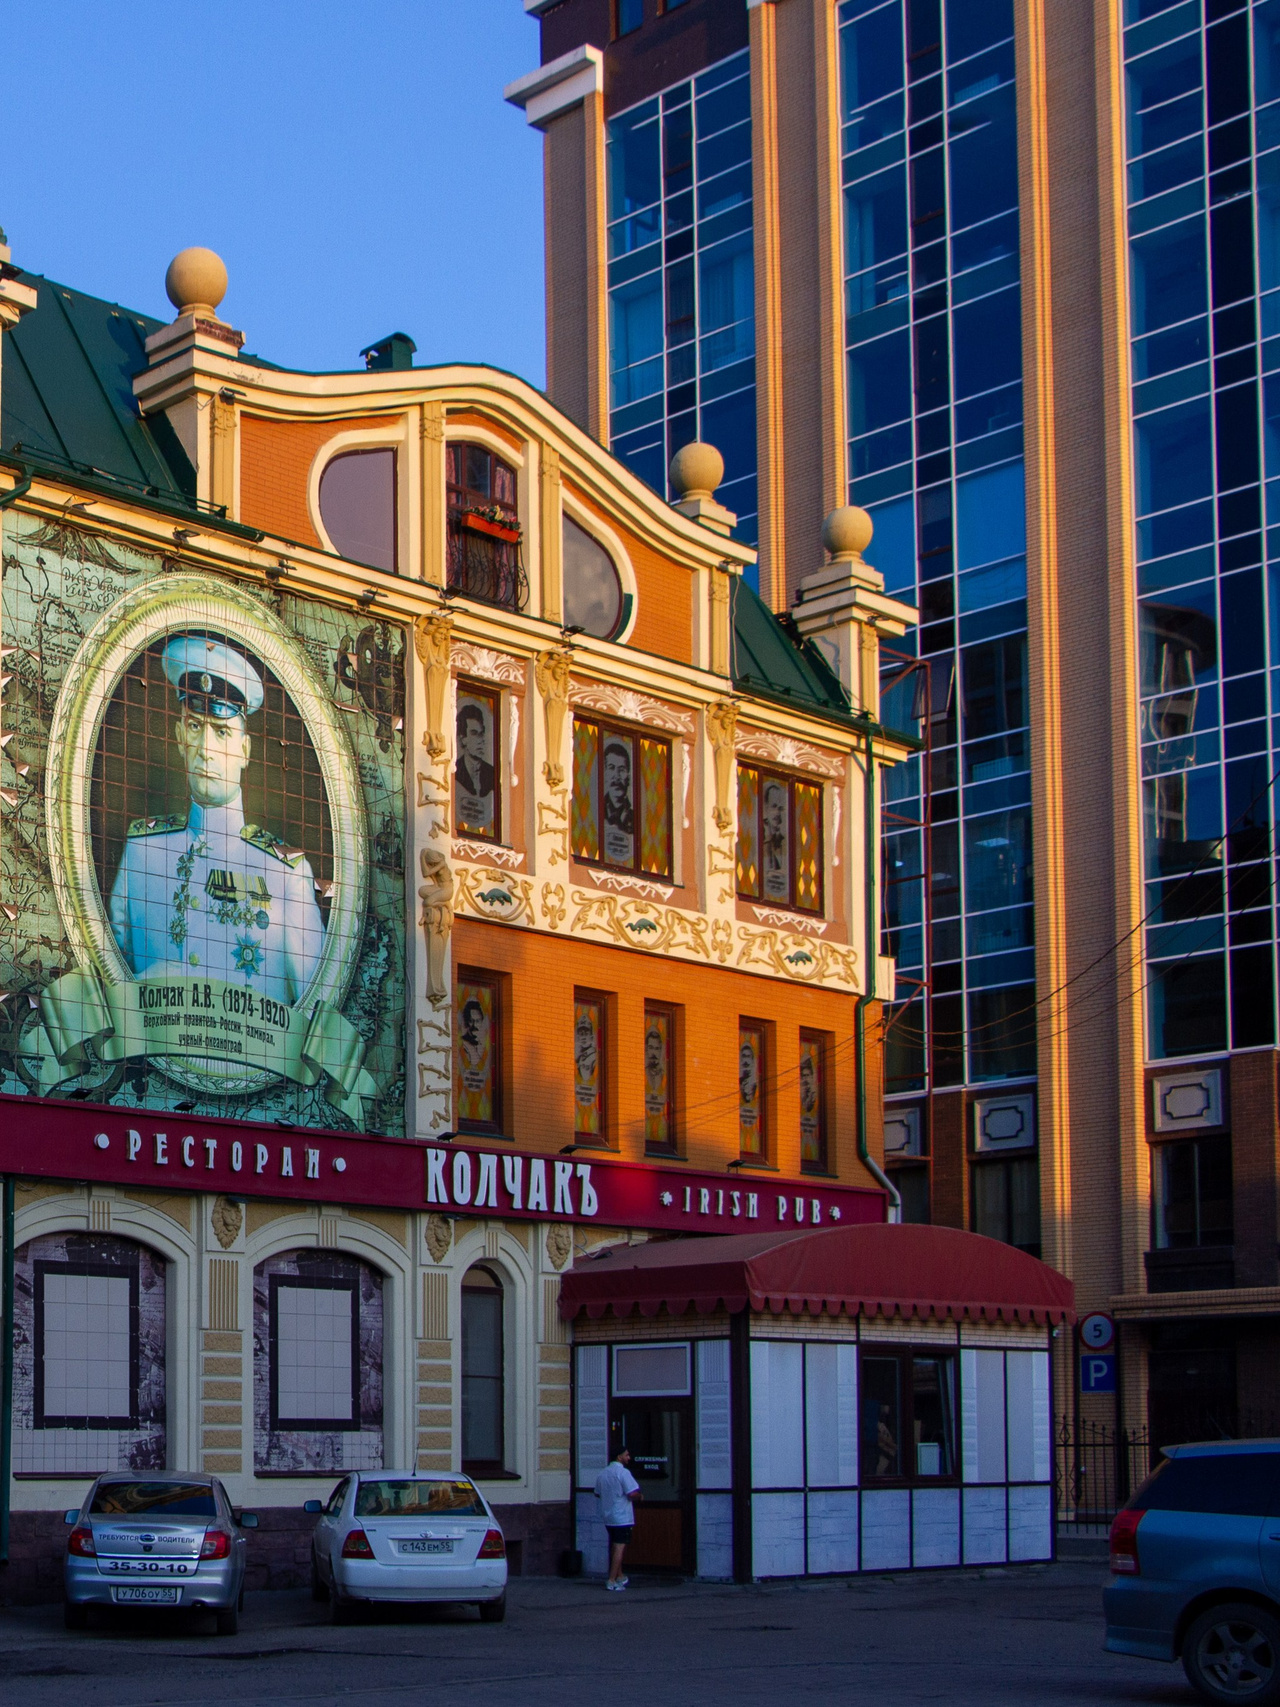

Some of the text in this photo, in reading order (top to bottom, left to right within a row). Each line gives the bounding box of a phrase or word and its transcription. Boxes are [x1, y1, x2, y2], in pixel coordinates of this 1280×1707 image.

[139, 983, 290, 1031] Колчак А.В. (1874-1920)
[144, 1012, 275, 1046] Верховный правитель России, адмирал,
[178, 1033, 242, 1055] ученый-океанограф
[126, 1129, 320, 1179] РЕСТОРАН
[426, 1148, 598, 1216] КОЛЧАКЪ
[682, 1186, 821, 1224] IRISH PUB
[1093, 1323, 1103, 1339] 5
[1089, 1360, 1108, 1387] P
[157, 1536, 195, 1544] ВОДИТЕЛИ
[109, 1561, 188, 1573] 35-30-10
